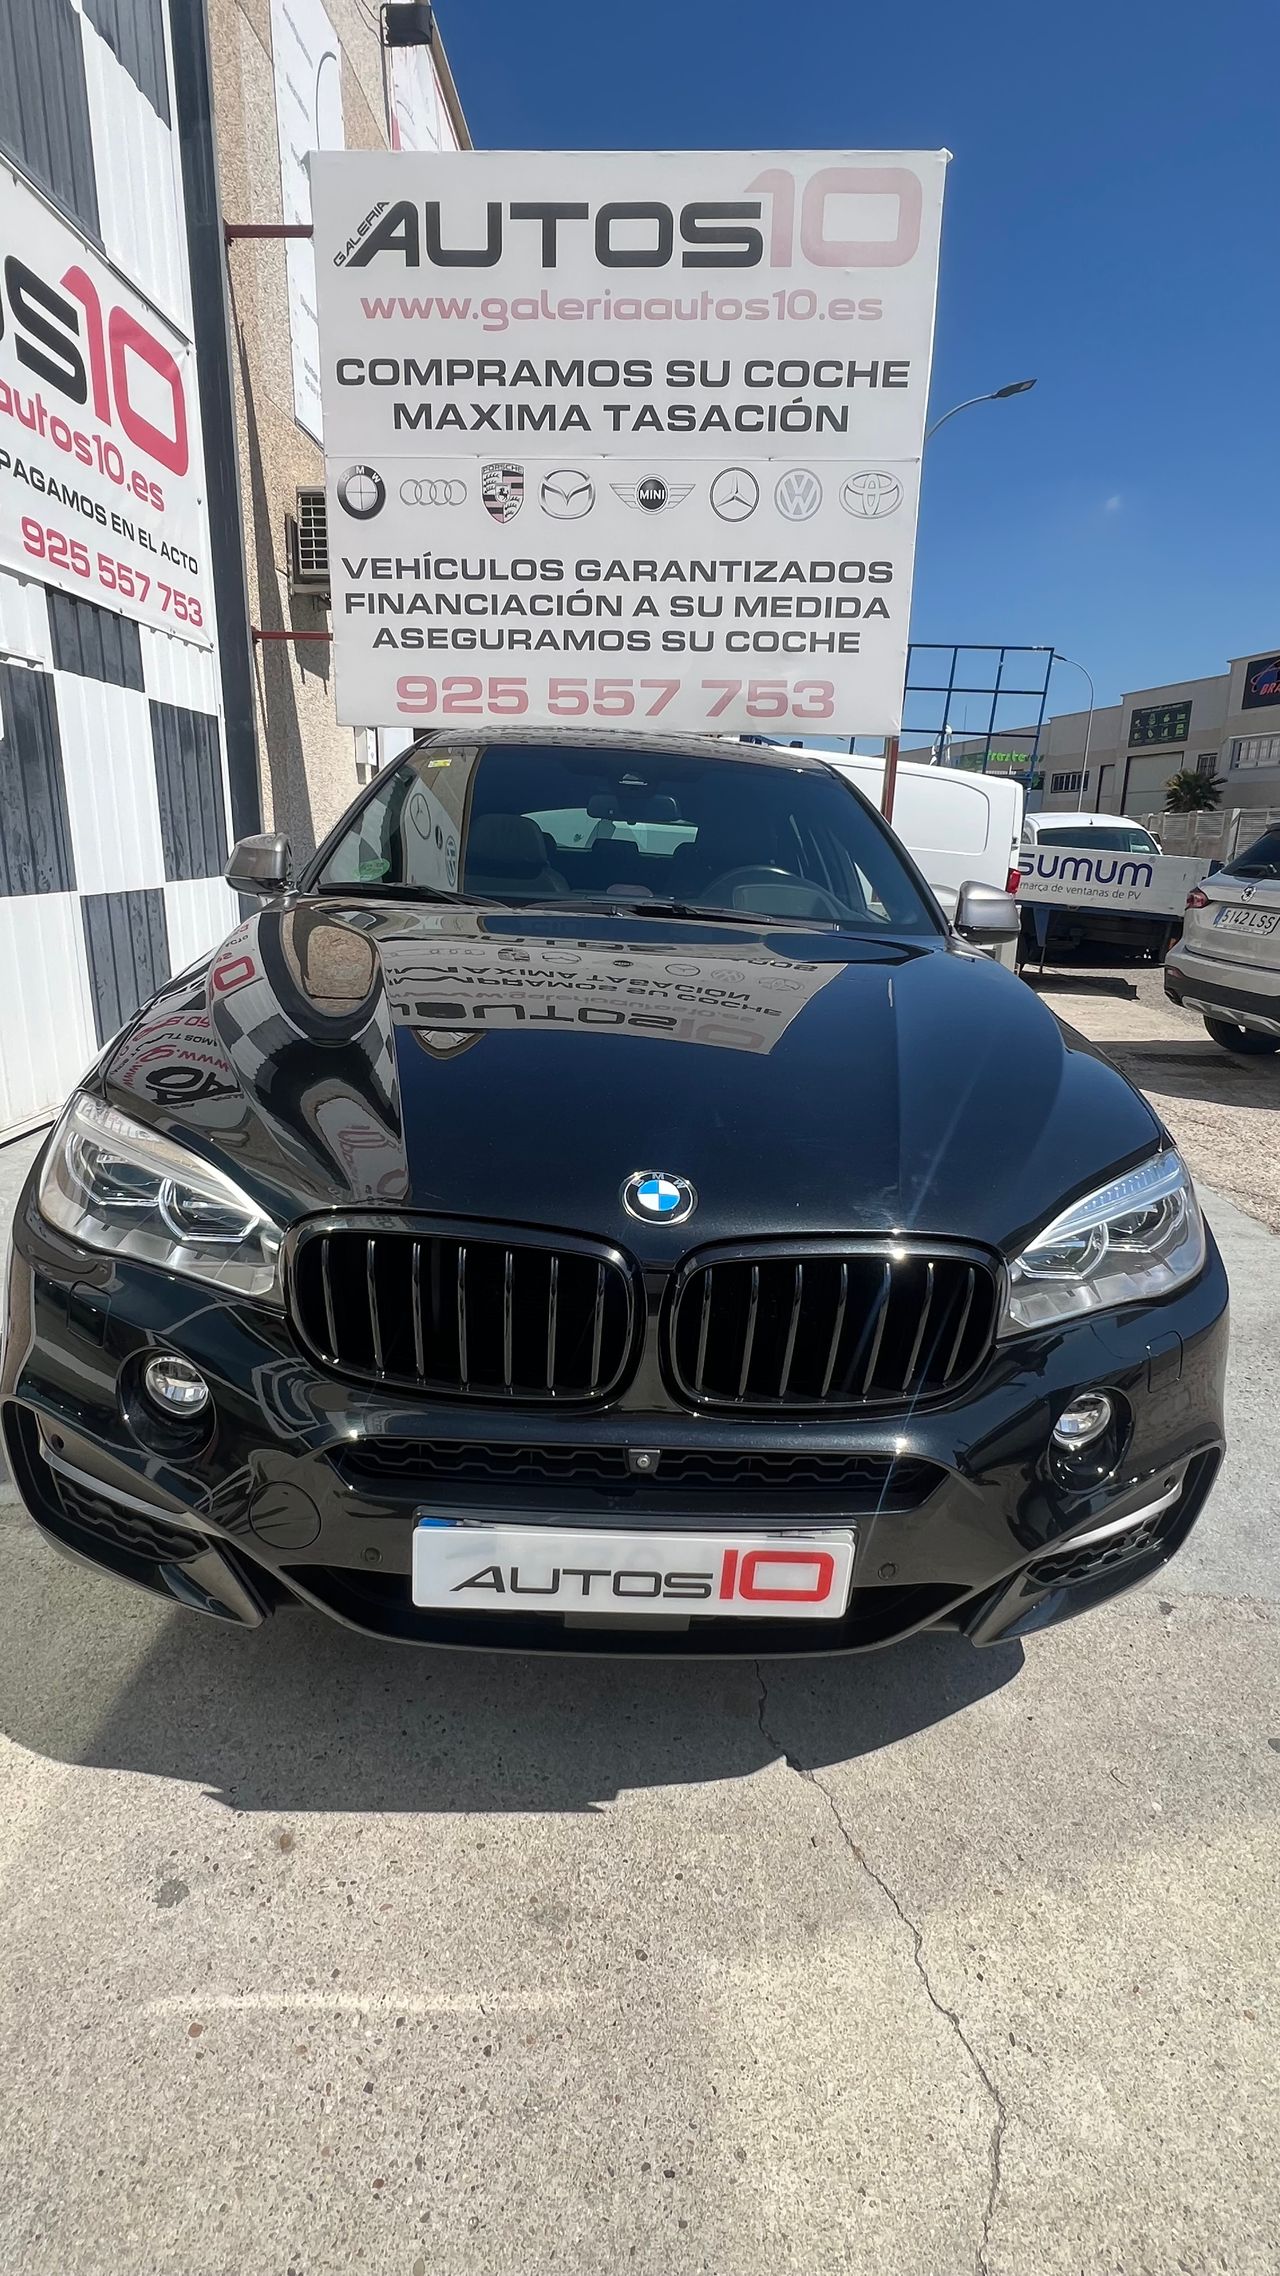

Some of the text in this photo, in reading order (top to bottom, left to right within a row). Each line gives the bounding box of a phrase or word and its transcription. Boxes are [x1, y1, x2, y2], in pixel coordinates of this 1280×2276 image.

[333, 202, 391, 267] GALERIA
[344, 167, 922, 268] AUTOS10
[360, 289, 883, 331] www.galeriaautos10.es
[0, 255, 188, 476] S10
[336, 358, 652, 388] COMPRAMOS
[666, 360, 730, 388] SU
[744, 360, 910, 388] COCHE
[394, 396, 848, 433] MAXIMA TASACIÓN
[640, 490, 664, 500] MINI
[111, 512, 134, 541] EN
[138, 528, 157, 553] EL
[160, 541, 198, 575] ACTO
[22, 516, 203, 627] 925 557 753
[342, 552, 893, 583] VEHÍCULOS GARANTIZADOS
[345, 588, 890, 618] FINANCIACIÓN A SU MEDIDA
[373, 629, 860, 653] ASEGURAMOS SU COCHE
[397, 676, 834, 719] 925 557 753
[1051, 885, 1063, 893] de
[1066, 886, 1109, 898] ventanas
[1112, 890, 1124, 899] de
[1128, 891, 1141, 900] PV
[1222, 910, 1275, 929] 5142 LSS
[449, 1549, 835, 1602] AUTOS10
